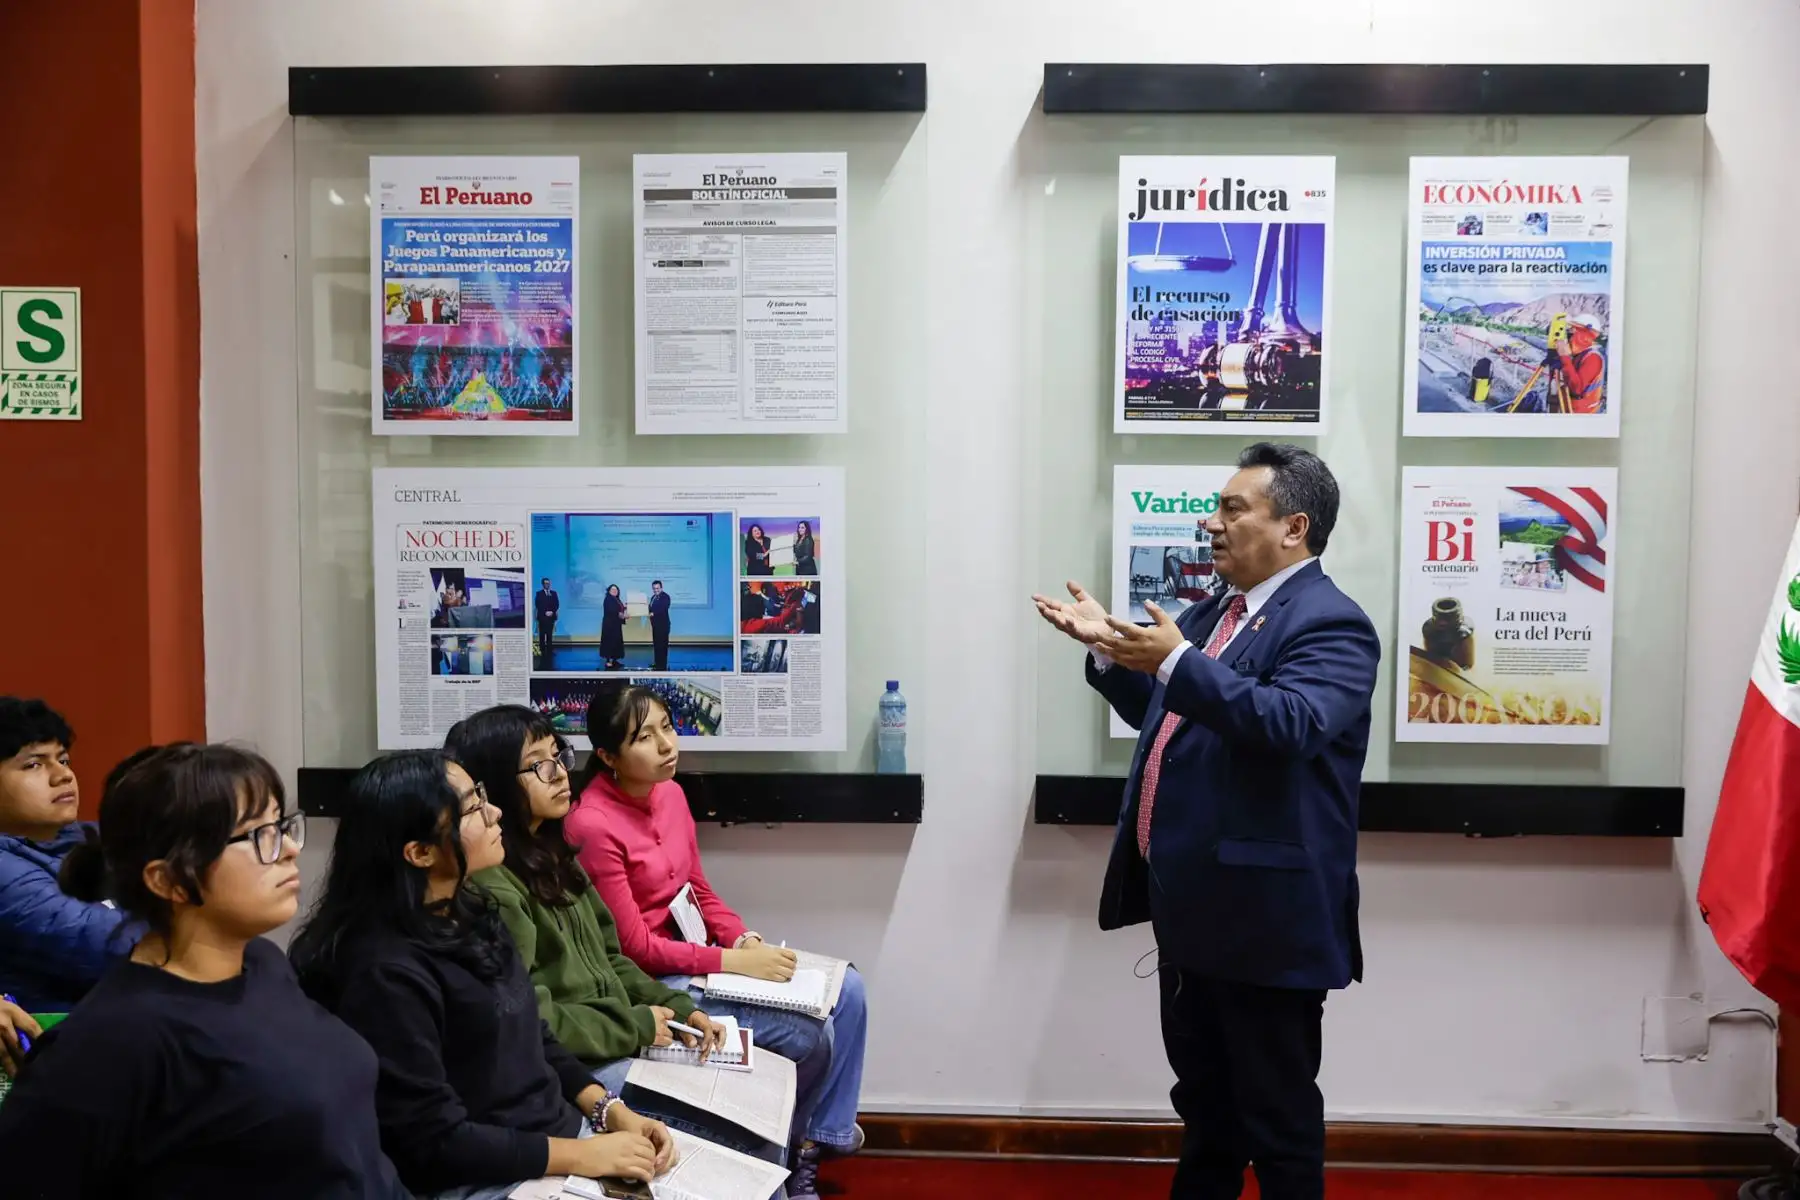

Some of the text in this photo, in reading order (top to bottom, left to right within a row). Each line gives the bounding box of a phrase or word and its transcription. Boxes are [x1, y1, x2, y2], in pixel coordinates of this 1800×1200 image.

[702, 174, 777, 186] El Peruano
[420, 186, 533, 205] El Peruano
[692, 189, 788, 200] BOLETÍN OFICIAL
[1128, 176, 1291, 221] jurídica
[1423, 180, 1583, 204] ECONÓMIKA
[406, 230, 548, 245] Perú organizará los
[387, 245, 566, 260] Juegos Panamericanos y
[1425, 245, 1565, 259] INVERSIÓN PRIVADA
[384, 260, 570, 275] Parapanamericanos 2027
[1423, 262, 1608, 275] es clave para la reactivación
[1132, 286, 1231, 303] El recurso
[1131, 304, 1240, 322] de casación
[16, 298, 66, 364] S
[13, 382, 33, 390] ZONA
[30, 399, 60, 407] SISMOS
[394, 490, 462, 503] CENTRAL
[1131, 491, 1221, 514] Varied
[405, 530, 517, 549] NOCHE DE
[1424, 517, 1476, 562] Bi
[400, 550, 522, 562] RECONOCIMIENTO
[1422, 562, 1478, 573] centenario
[1495, 607, 1567, 622] La nueva
[1494, 625, 1592, 641] era del Perú
[1409, 692, 1482, 724] 200
